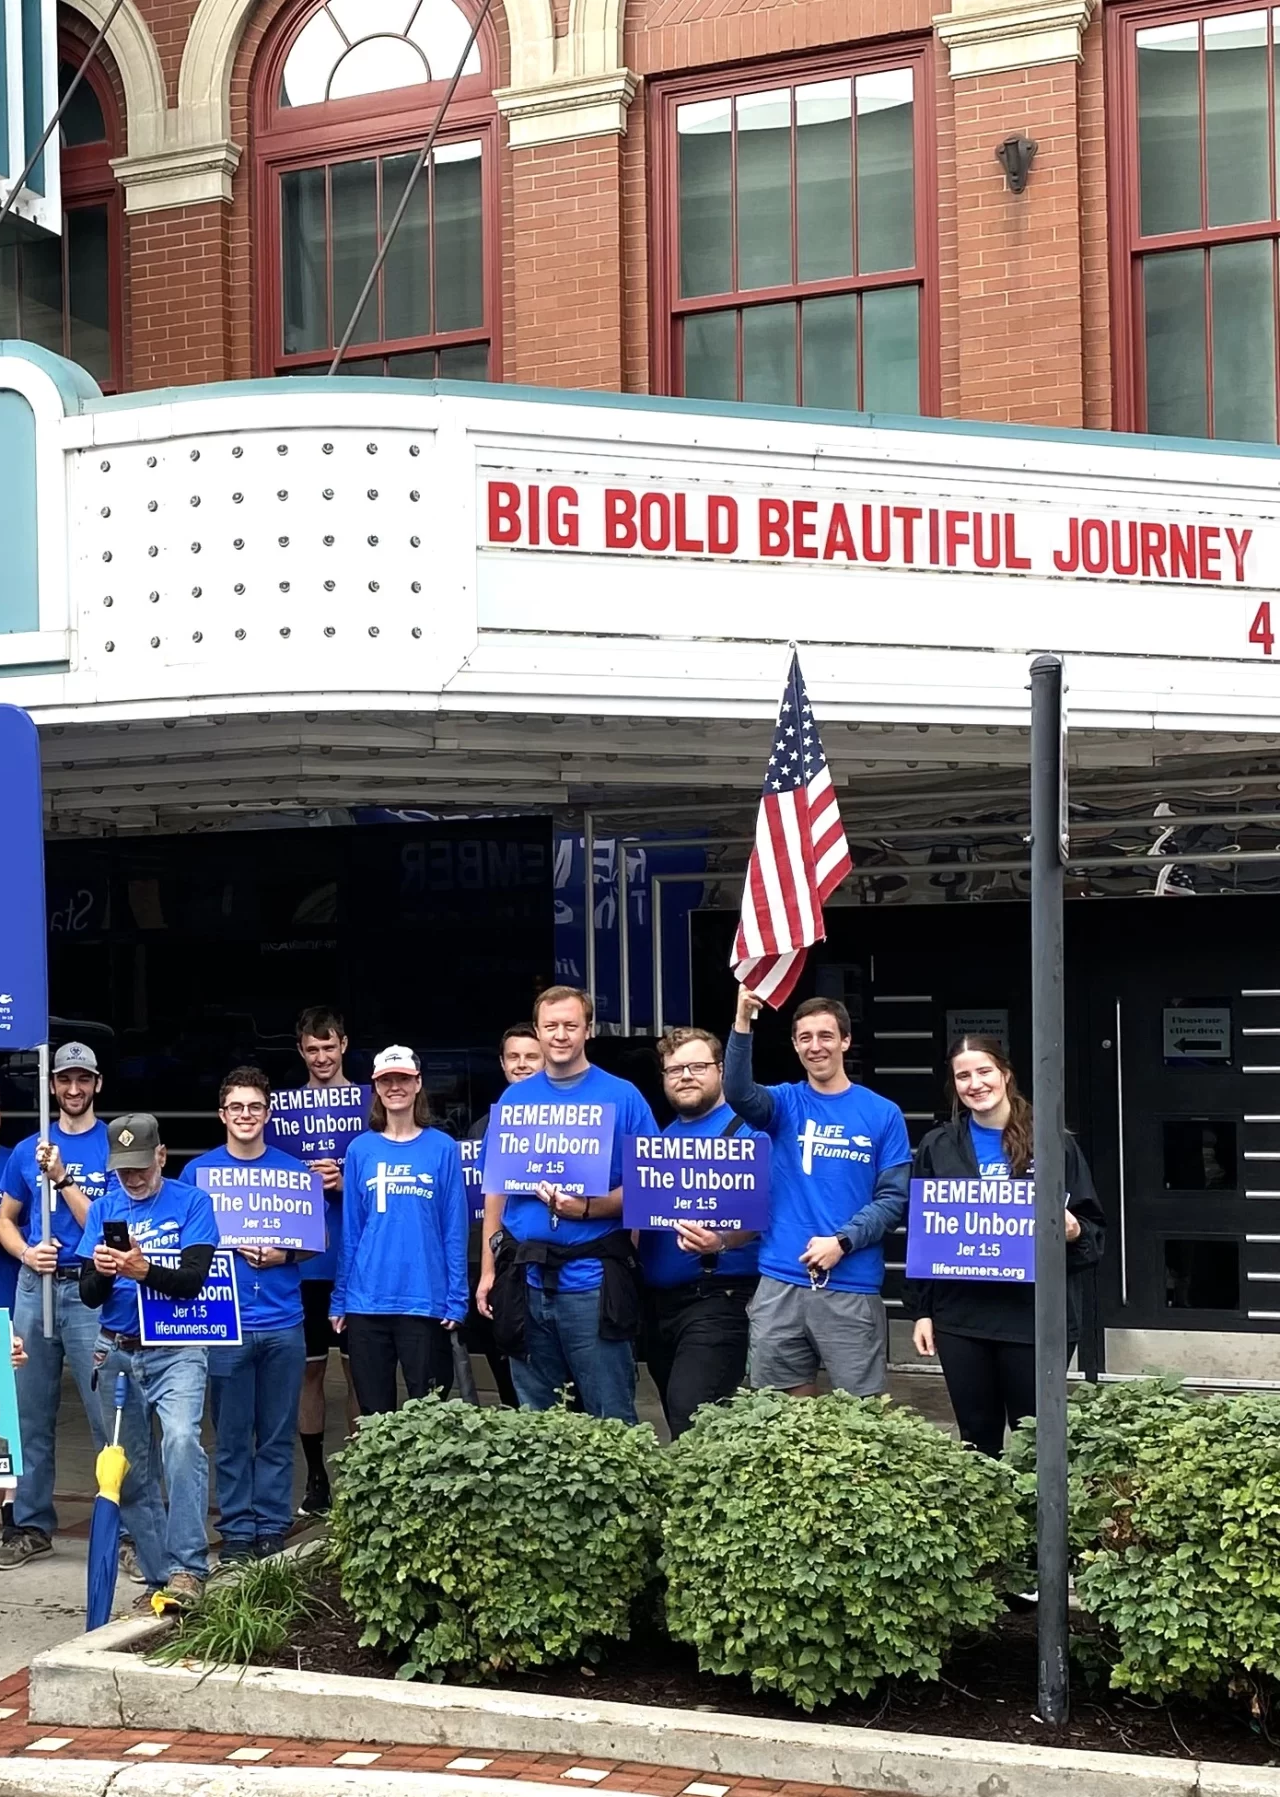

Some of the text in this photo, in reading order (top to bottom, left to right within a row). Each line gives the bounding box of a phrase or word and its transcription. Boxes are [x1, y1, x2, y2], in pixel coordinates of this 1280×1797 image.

[487, 481, 1255, 582] BIG BOLD BEAUTIFUL JOURNEY
[1248, 601, 1275, 655] 4
[270, 1087, 362, 1111] REMEMBER
[500, 1105, 603, 1126] REMEMBER
[272, 1114, 362, 1136] The Unborn
[815, 1125, 845, 1138] LIFE
[301, 1139, 335, 1152] Jer 1:5
[499, 1133, 533, 1154] The
[534, 1133, 600, 1155] Unborn
[636, 1137, 755, 1160] REMEMBER
[812, 1143, 871, 1163] Runners
[386, 1165, 411, 1176] LIFE
[525, 1161, 564, 1173] Jer 1:5
[978, 1163, 1009, 1175] LIFE
[208, 1168, 312, 1191] REMEMBER
[637, 1166, 755, 1190] The Unborn
[387, 1182, 434, 1199] Runners
[210, 1193, 312, 1215] The Unborn
[673, 1197, 717, 1210] Jer 1:5
[242, 1218, 281, 1229] Jer 1:5
[923, 1212, 958, 1235] The
[220, 1235, 302, 1248] liferunners.org
[956, 1243, 1000, 1256] Jer 1:5
[932, 1264, 1025, 1279] liferunners.org
[172, 1305, 208, 1318] Jer 1:5
[155, 1321, 228, 1337] liferunners.org
